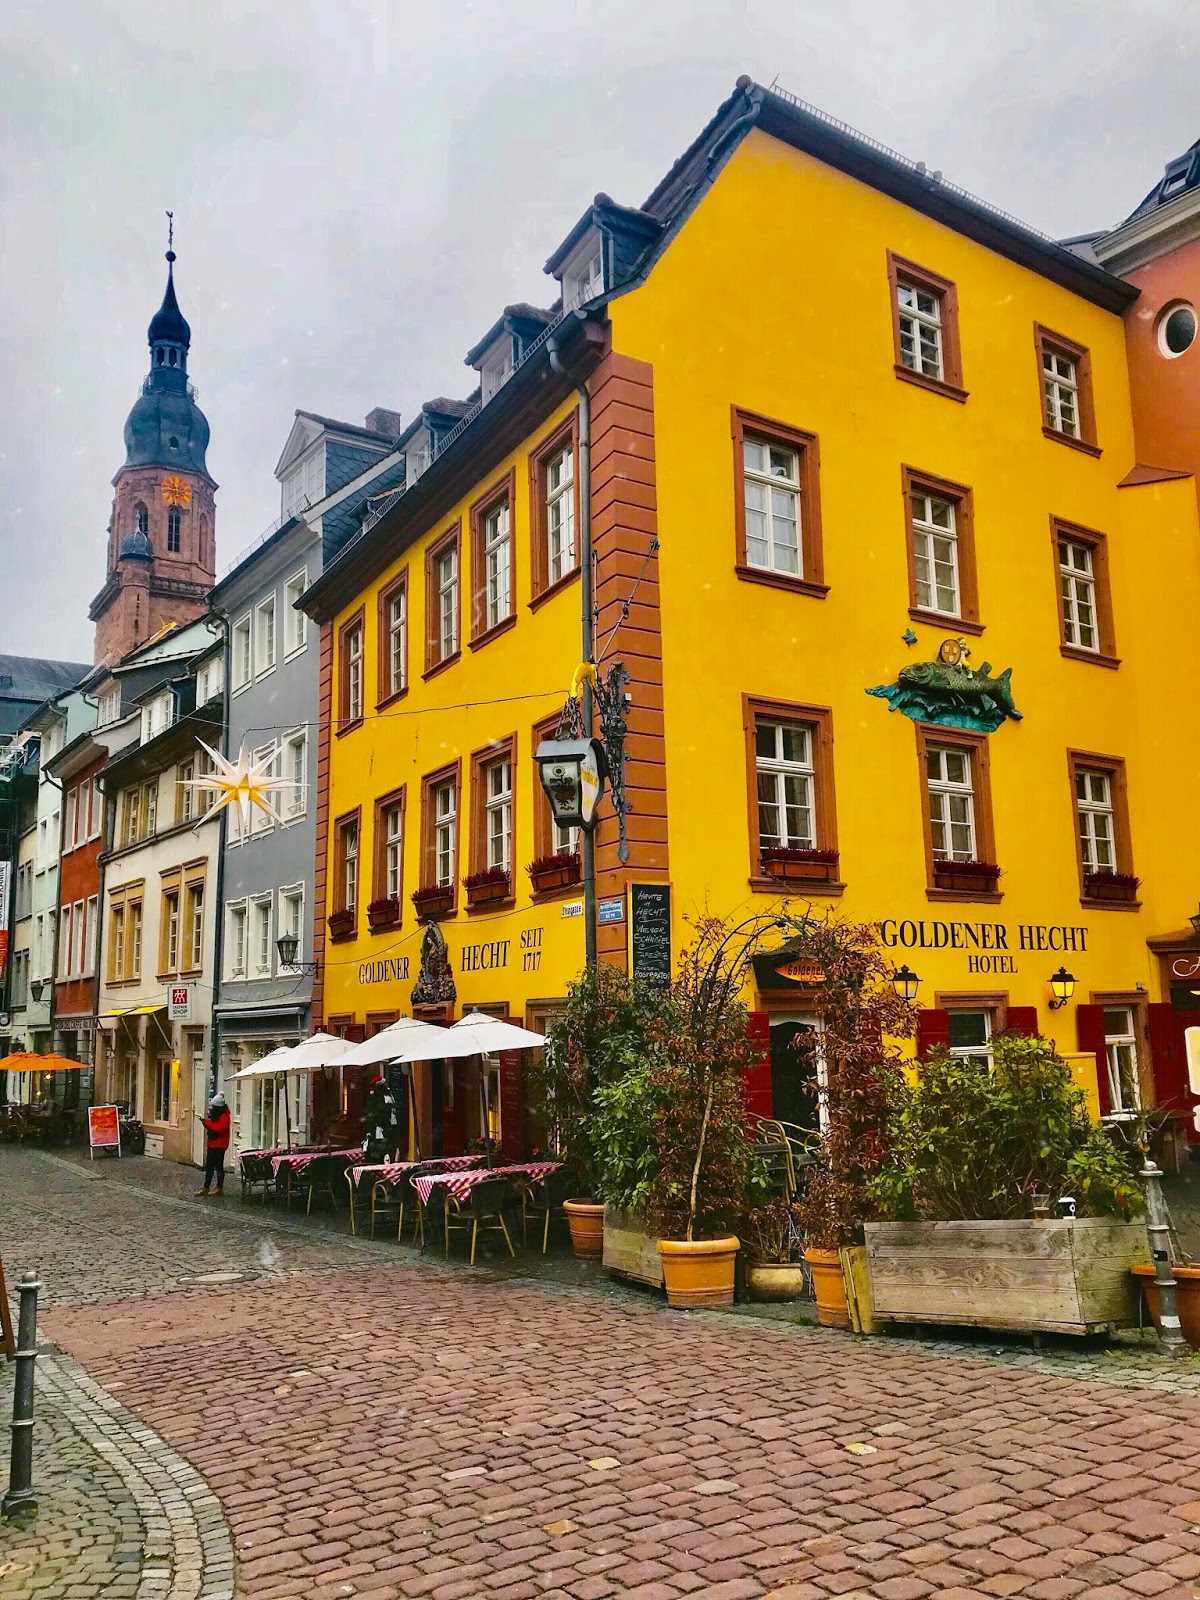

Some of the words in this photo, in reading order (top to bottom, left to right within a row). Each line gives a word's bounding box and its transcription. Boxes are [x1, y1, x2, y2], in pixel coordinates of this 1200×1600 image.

[636, 908, 667, 916] HECHT
[519, 927, 544, 949] SEIT
[880, 919, 1009, 949] GOLDENER
[1018, 925, 1089, 952] HECHT
[358, 956, 410, 985] GOLDENER
[461, 940, 511, 972] HECHT
[522, 951, 542, 972] 1717
[968, 955, 1018, 974] HOTEL
